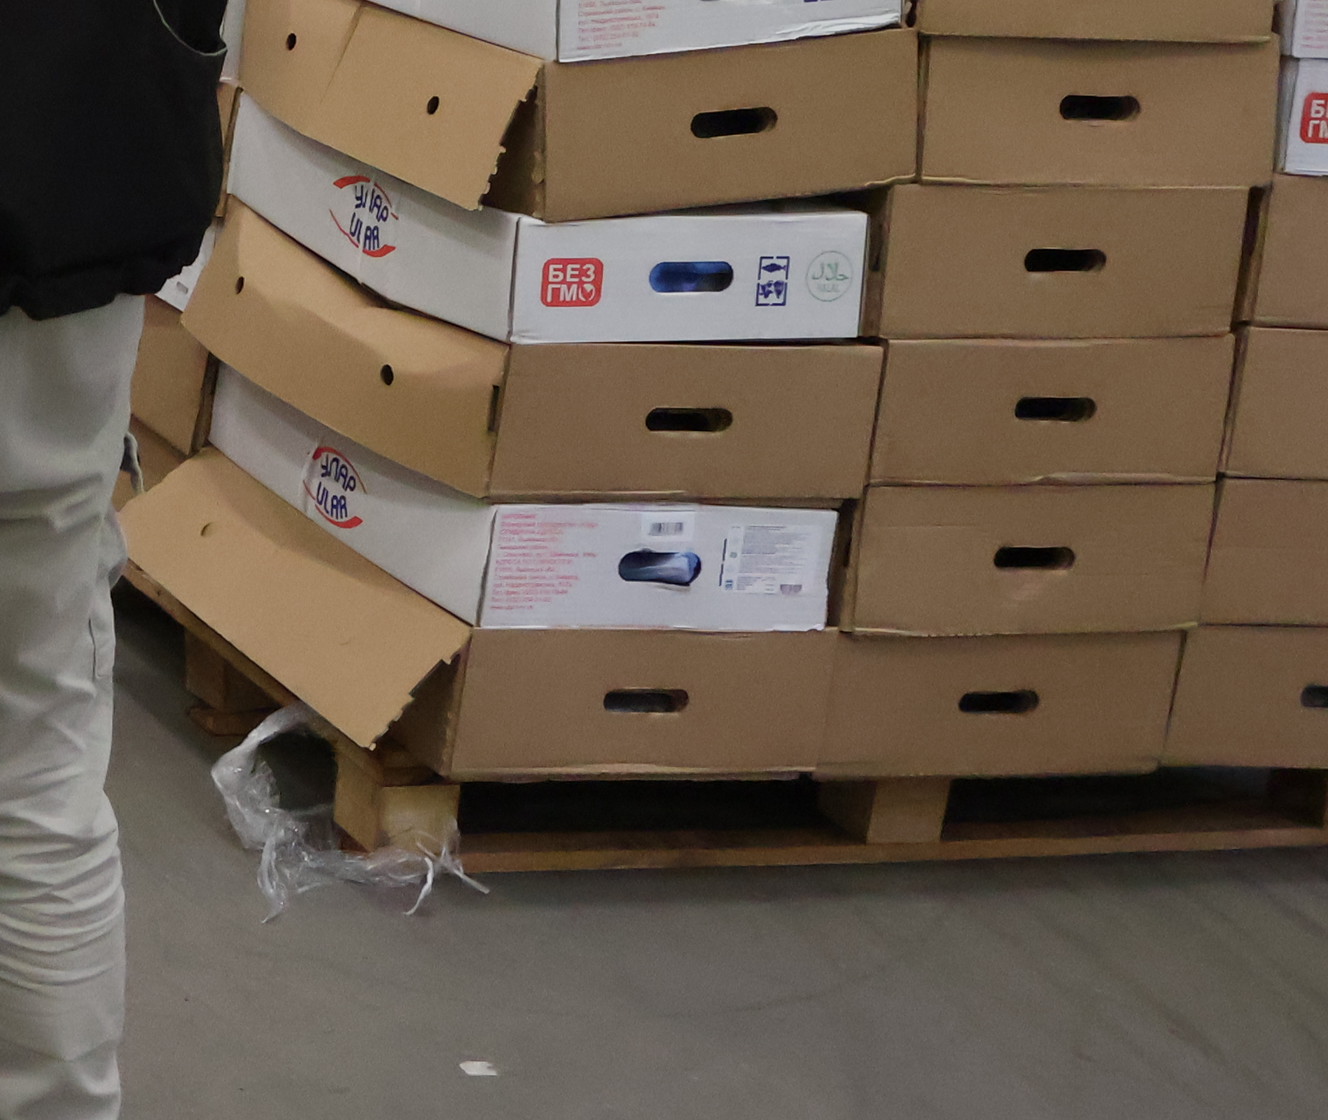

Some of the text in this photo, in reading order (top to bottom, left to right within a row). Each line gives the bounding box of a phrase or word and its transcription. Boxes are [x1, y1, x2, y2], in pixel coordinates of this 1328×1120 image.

[548, 263, 596, 282] БЕЗ
[547, 283, 596, 303] ГМО
[320, 453, 357, 492] УЛАР
[316, 481, 348, 520] ULAR
